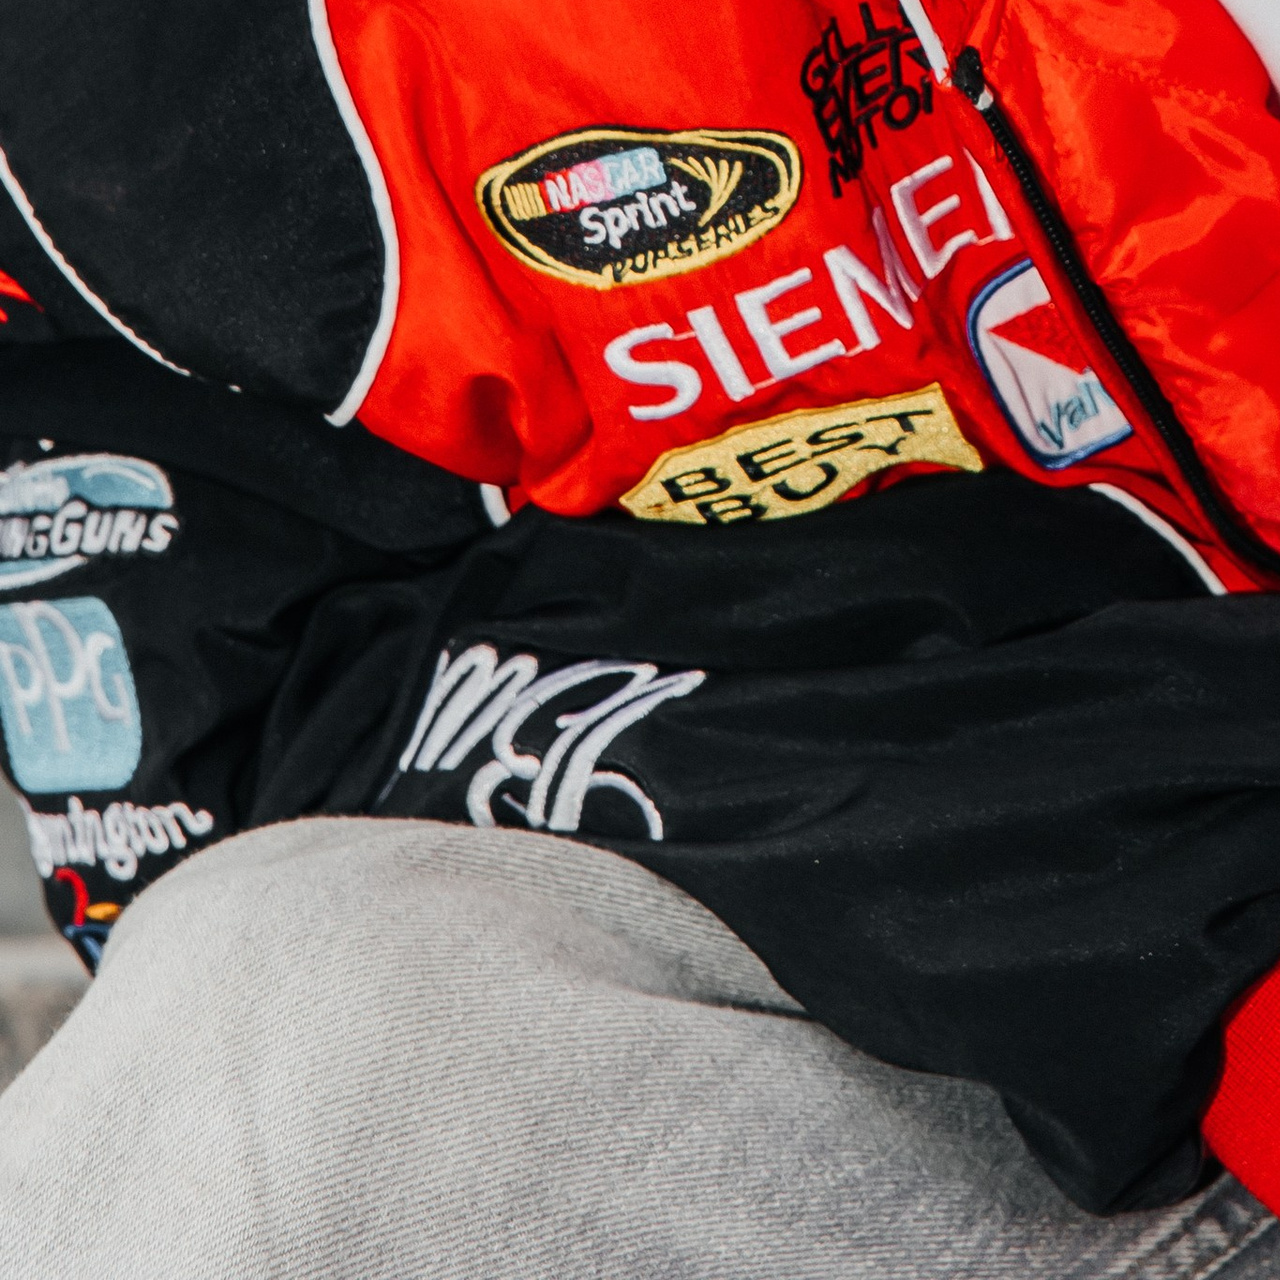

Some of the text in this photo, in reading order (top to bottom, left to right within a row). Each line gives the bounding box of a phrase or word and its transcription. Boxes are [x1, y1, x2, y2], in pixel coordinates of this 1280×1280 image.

[543, 149, 664, 213] NASCAR
[579, 180, 697, 250] Sprint
[660, 408, 933, 504] BEST
